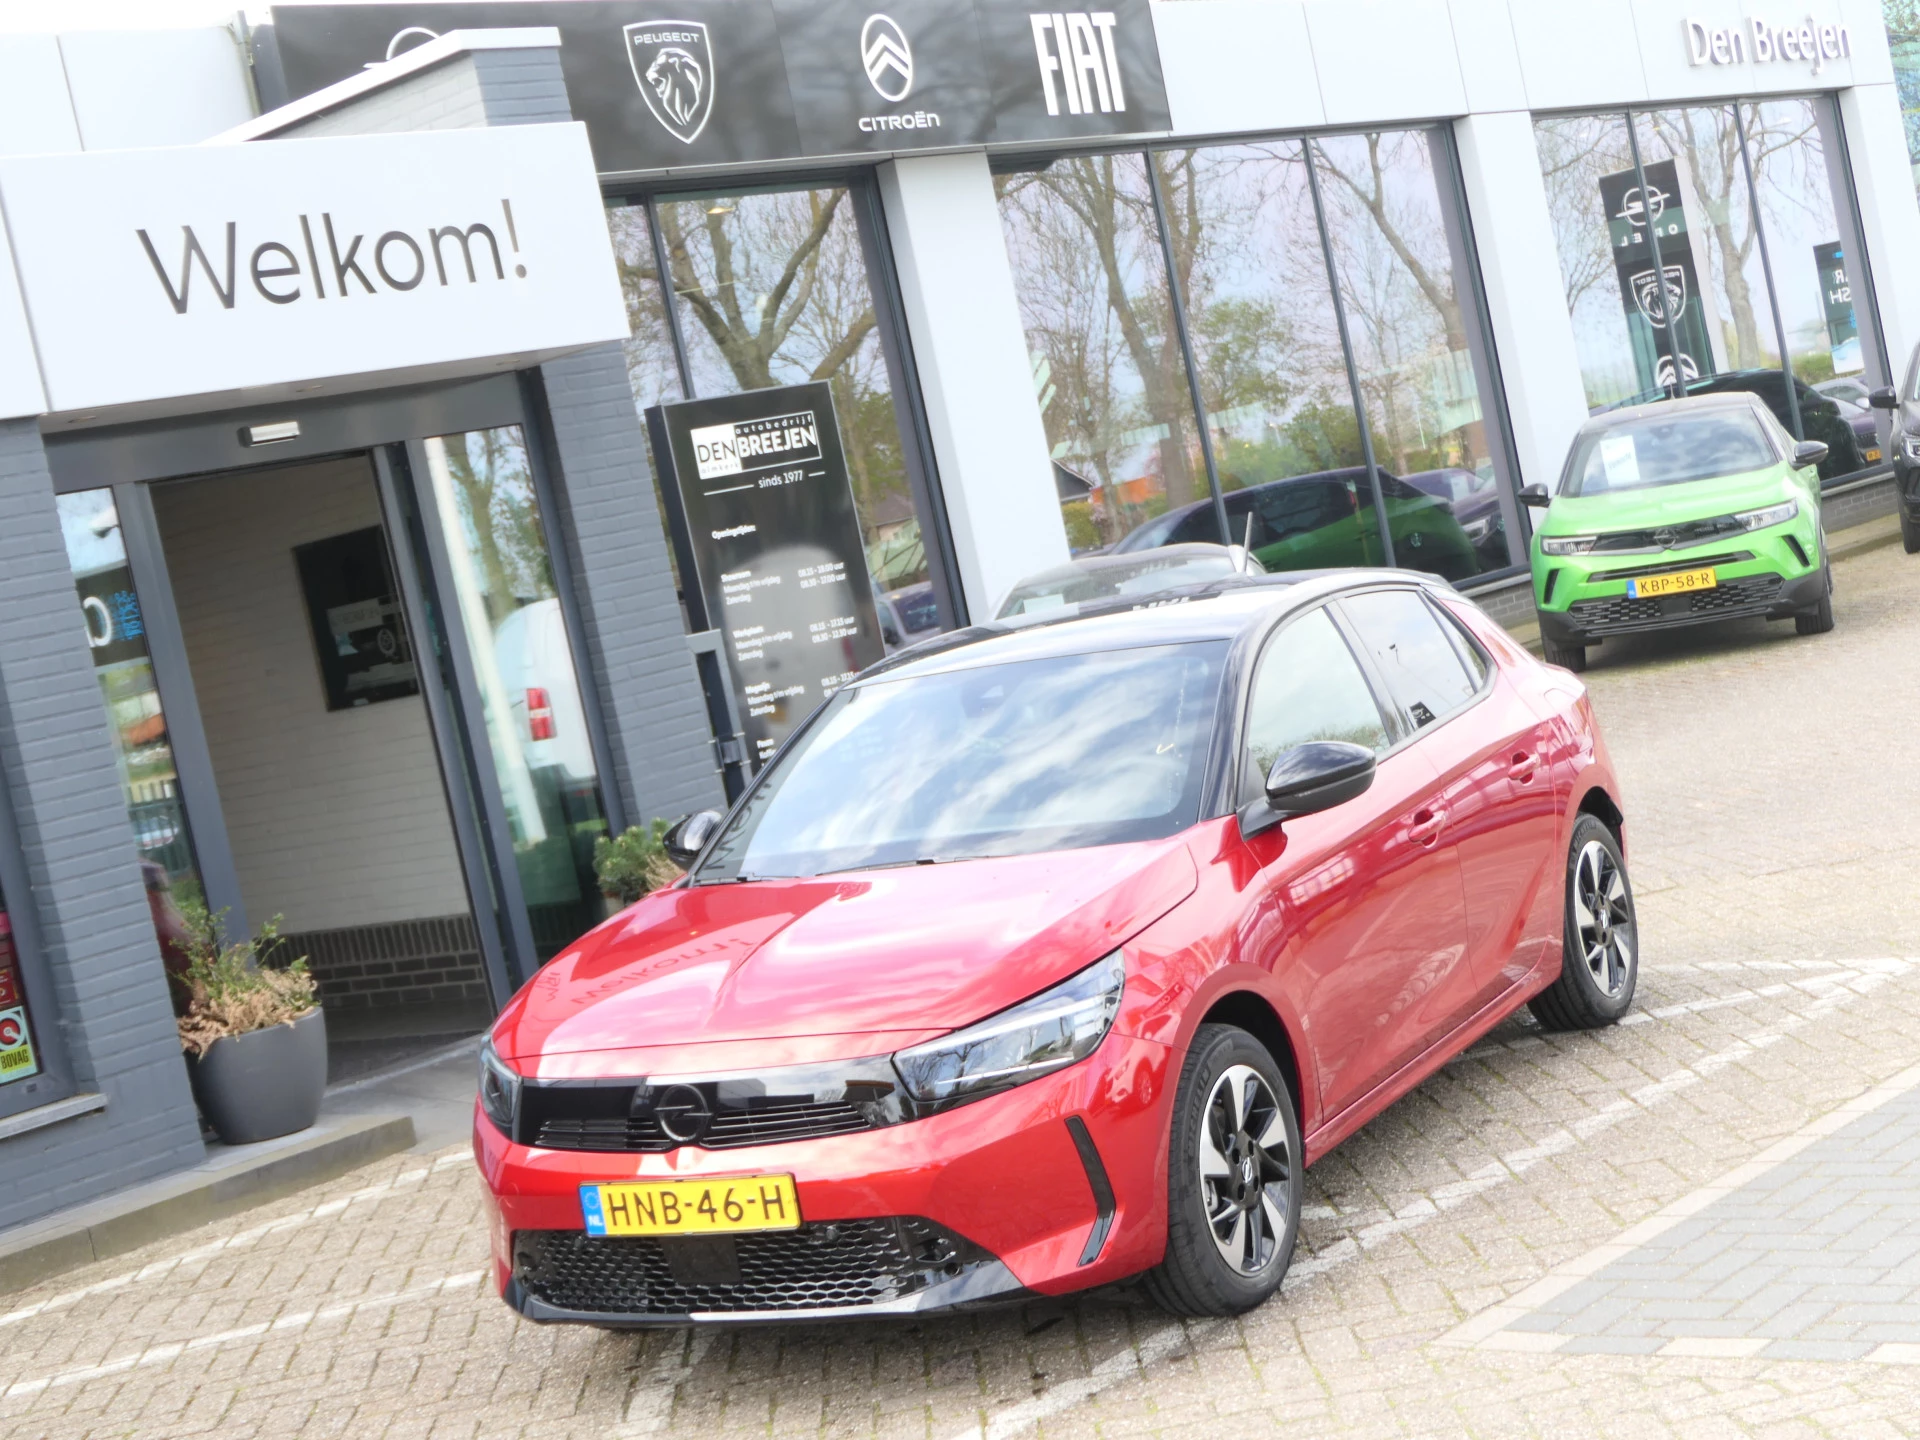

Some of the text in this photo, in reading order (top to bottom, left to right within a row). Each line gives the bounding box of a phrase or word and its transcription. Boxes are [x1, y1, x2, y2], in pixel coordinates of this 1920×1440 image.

[633, 32, 700, 46] PEUGEOT
[1681, 11, 1850, 76] Den Breejen
[1030, 12, 1126, 116] FIAT
[135, 198, 528, 315] Welkom!
[735, 414, 813, 435] autobedrijf
[697, 425, 818, 463] DEN BREEJEN
[758, 470, 803, 489] sinds 1977
[1640, 572, 1711, 594] KBP-58-R
[1, 1048, 30, 1070] BOVAG
[588, 1184, 786, 1228] NL HNB-46-H
